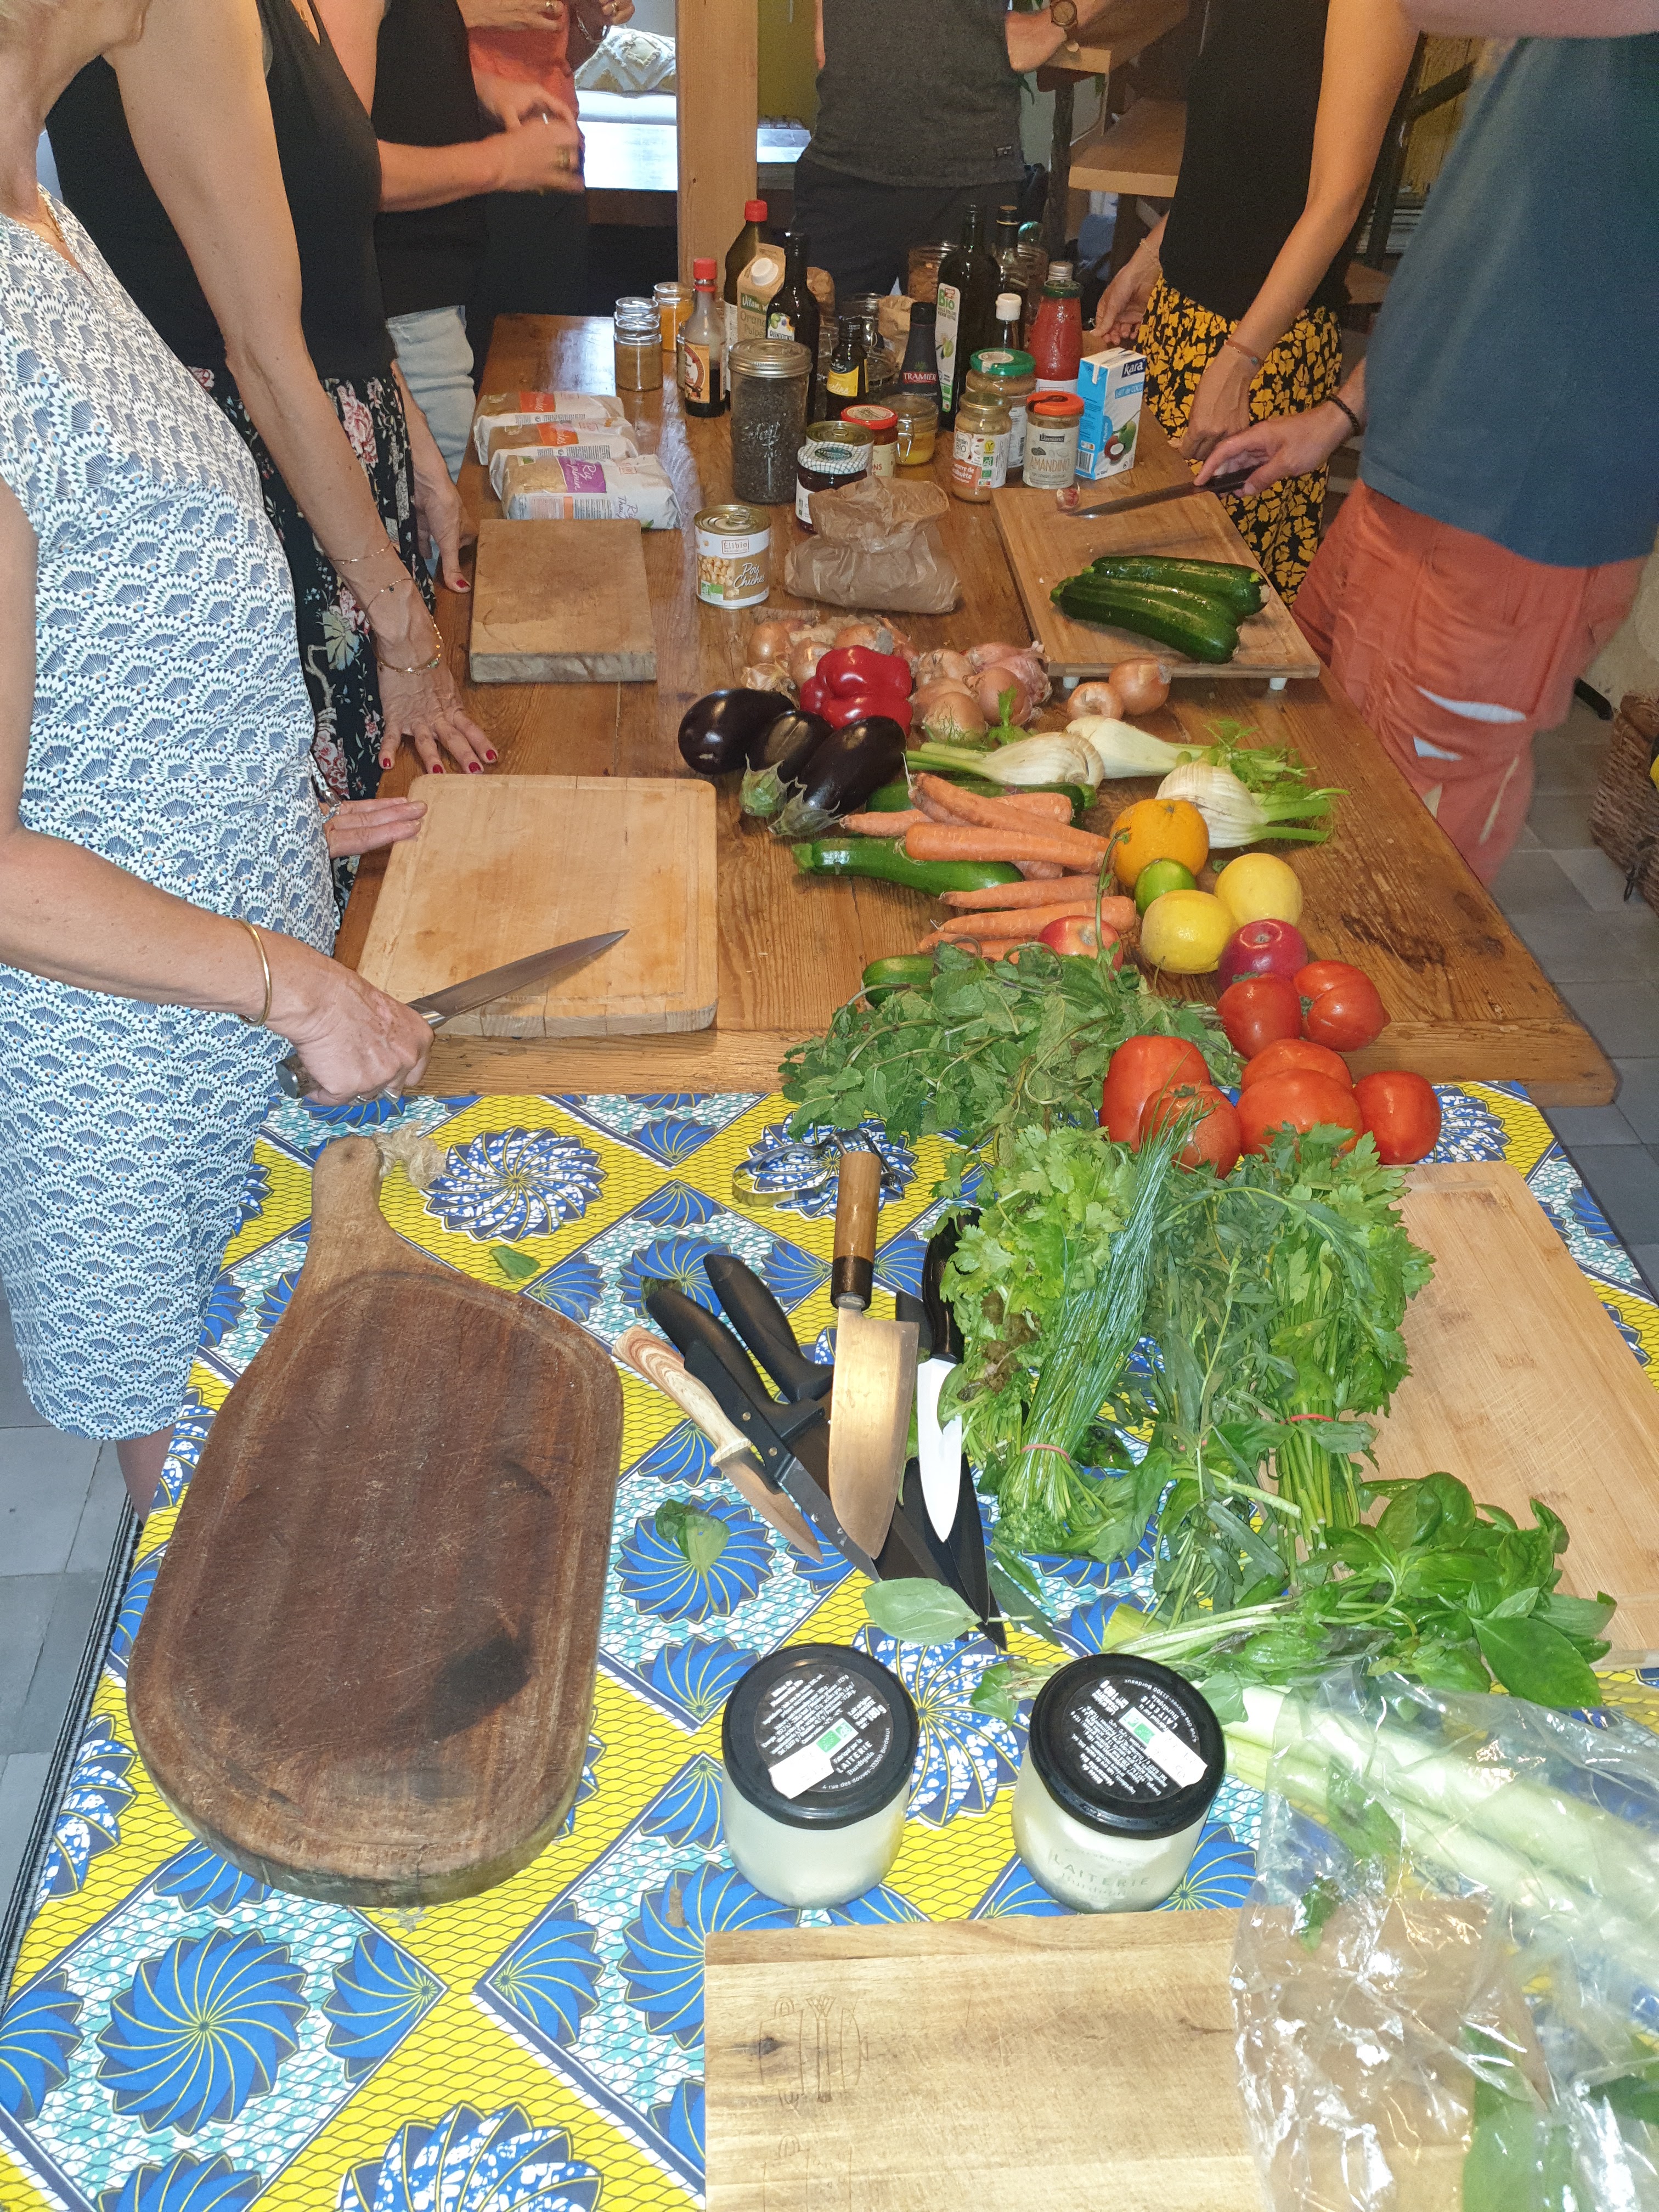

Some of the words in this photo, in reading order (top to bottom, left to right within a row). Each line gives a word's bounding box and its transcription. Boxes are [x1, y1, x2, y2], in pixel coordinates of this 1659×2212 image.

[1123, 361, 1143, 376] kara
[904, 373, 937, 382] TRAMIER
[580, 464, 597, 481] Riz
[742, 562, 760, 577] Pois
[1103, 1684, 1119, 1700] 180
[1125, 1679, 1152, 1689] Bordeaux
[852, 1699, 876, 1720] CHARENTE
[865, 1706, 881, 1722] 180
[1104, 1705, 1115, 1716] Lait
[1140, 1694, 1178, 1730] LAITERIE
[1143, 1707, 1152, 1716] par
[1150, 1693, 1179, 1721] Burdigala
[850, 1741, 859, 1750] par
[881, 1728, 889, 1752] Bordeaux
[836, 1740, 873, 1774] LAITERIE
[846, 1750, 875, 1776] Burdigala
[1079, 1752, 1090, 1763] Bio
[1054, 1853, 1150, 1887] LAITERIE
